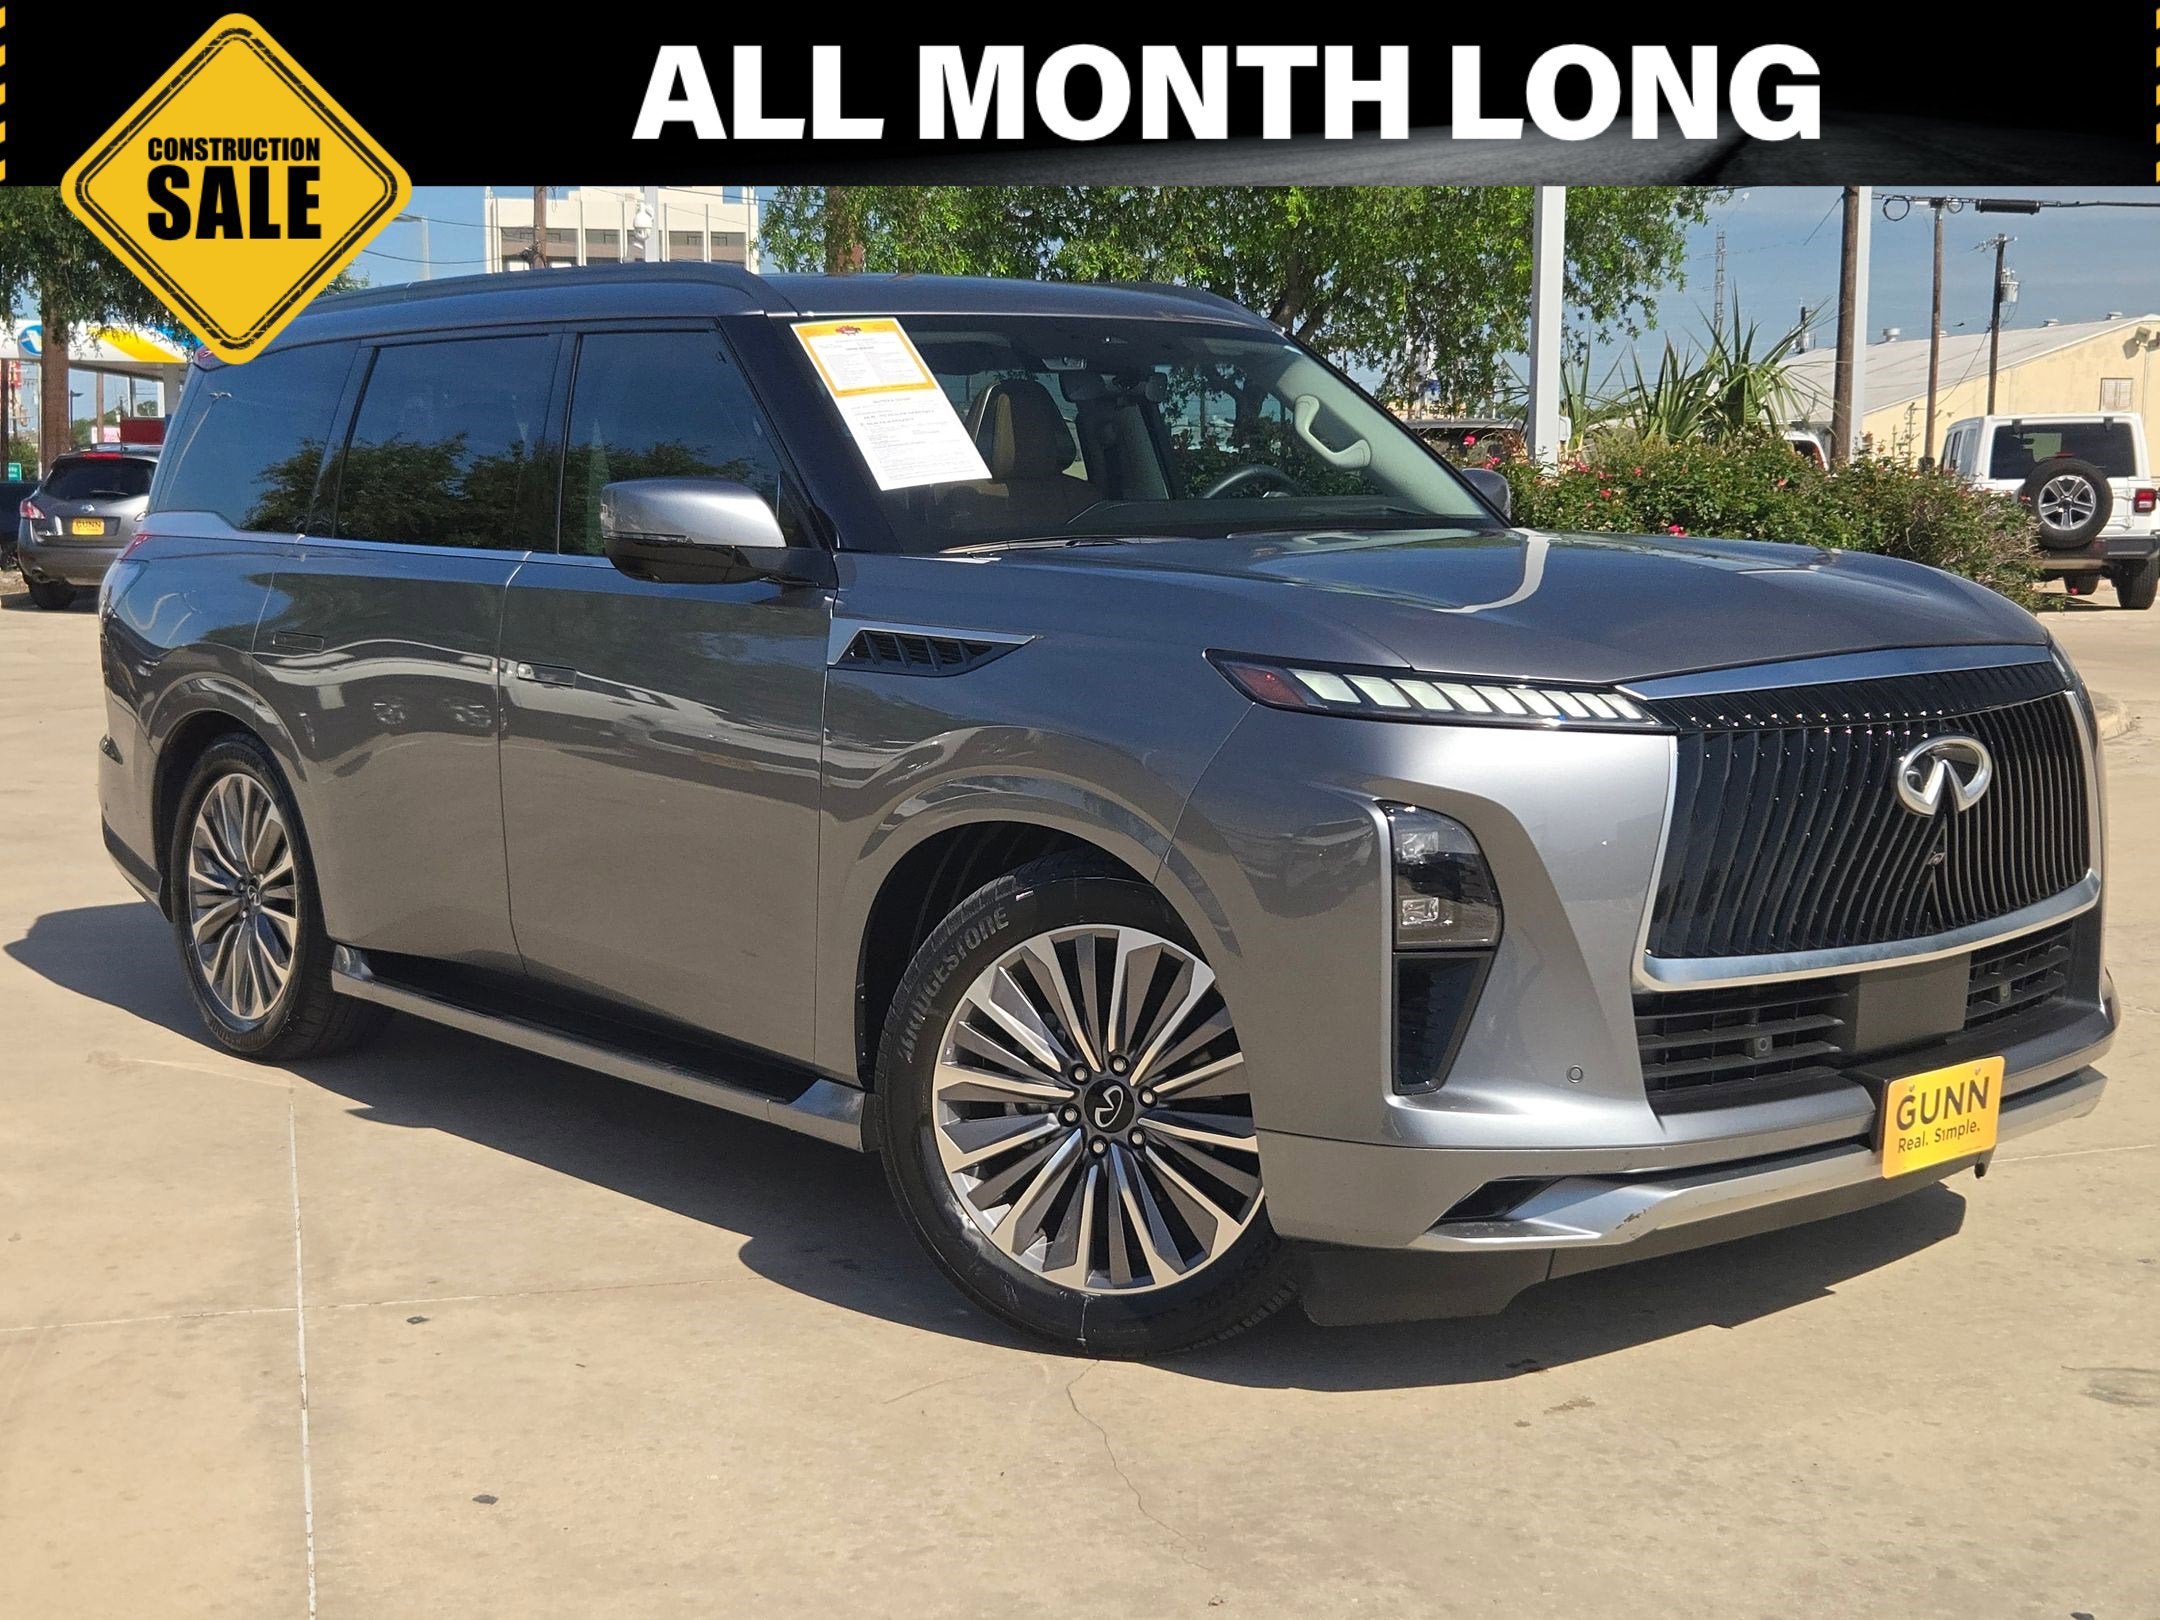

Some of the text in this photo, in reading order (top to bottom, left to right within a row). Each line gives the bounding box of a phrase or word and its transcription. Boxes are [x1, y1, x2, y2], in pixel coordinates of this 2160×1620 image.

[1896, 1076, 1990, 1131] GUNN
[1897, 1119, 1981, 1154] Real. Simple.
